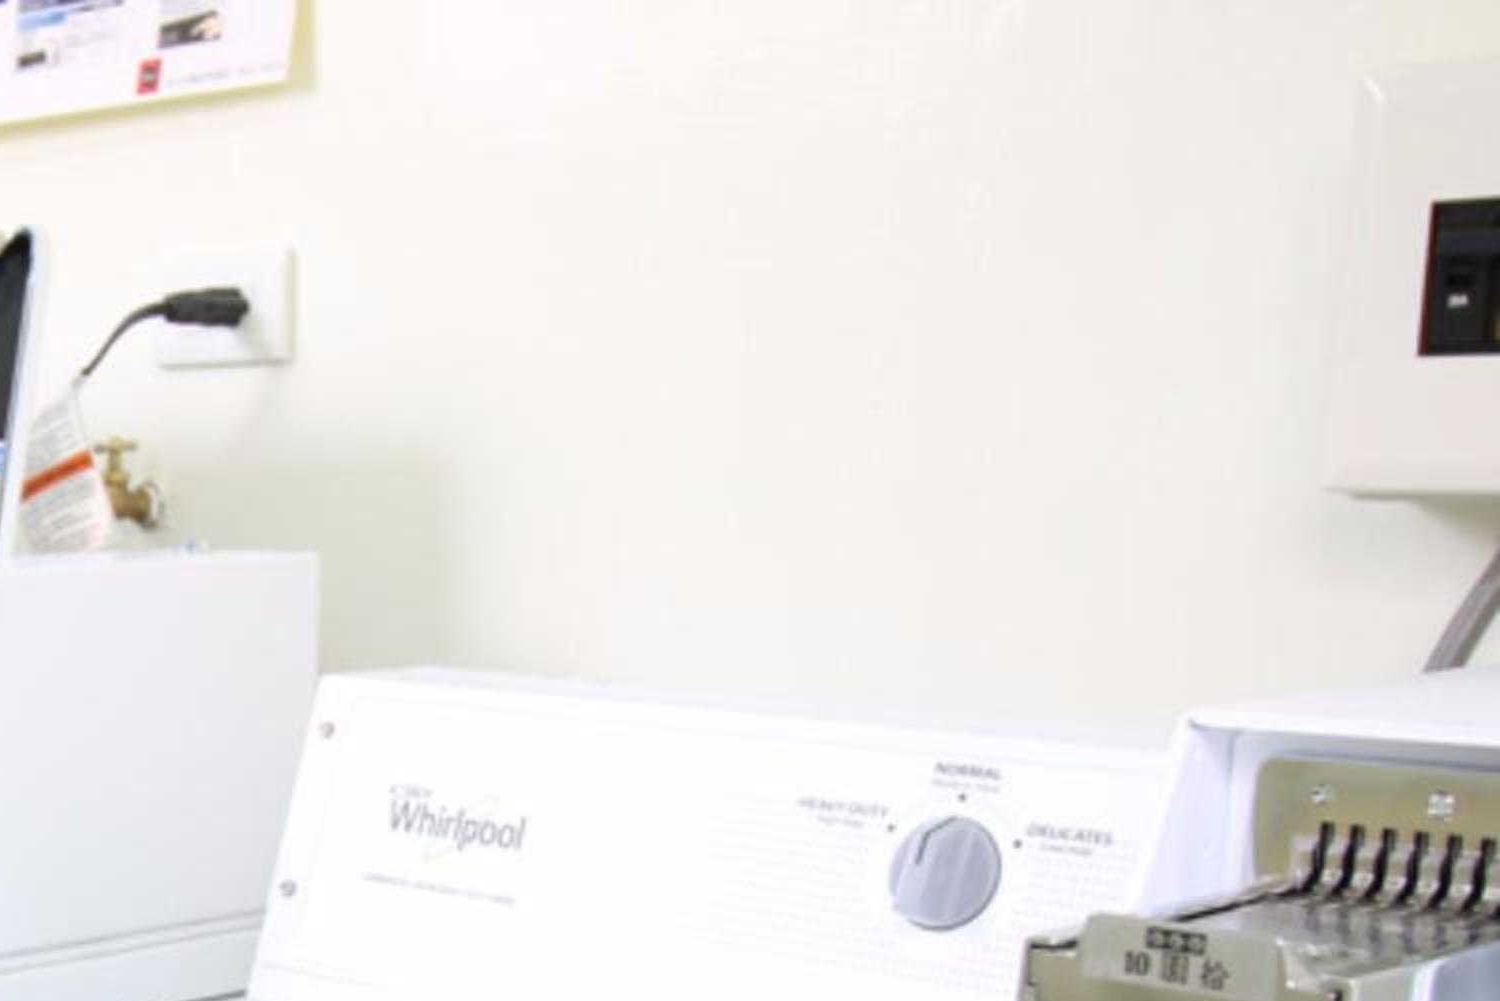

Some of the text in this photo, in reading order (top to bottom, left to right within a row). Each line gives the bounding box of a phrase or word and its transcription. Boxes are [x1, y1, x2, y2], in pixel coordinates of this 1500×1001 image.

[934, 761, 1001, 781] NORMAL
[847, 801, 889, 819] DUTY
[388, 799, 527, 852] Whirlpool
[1025, 821, 1113, 848] DELICATES
